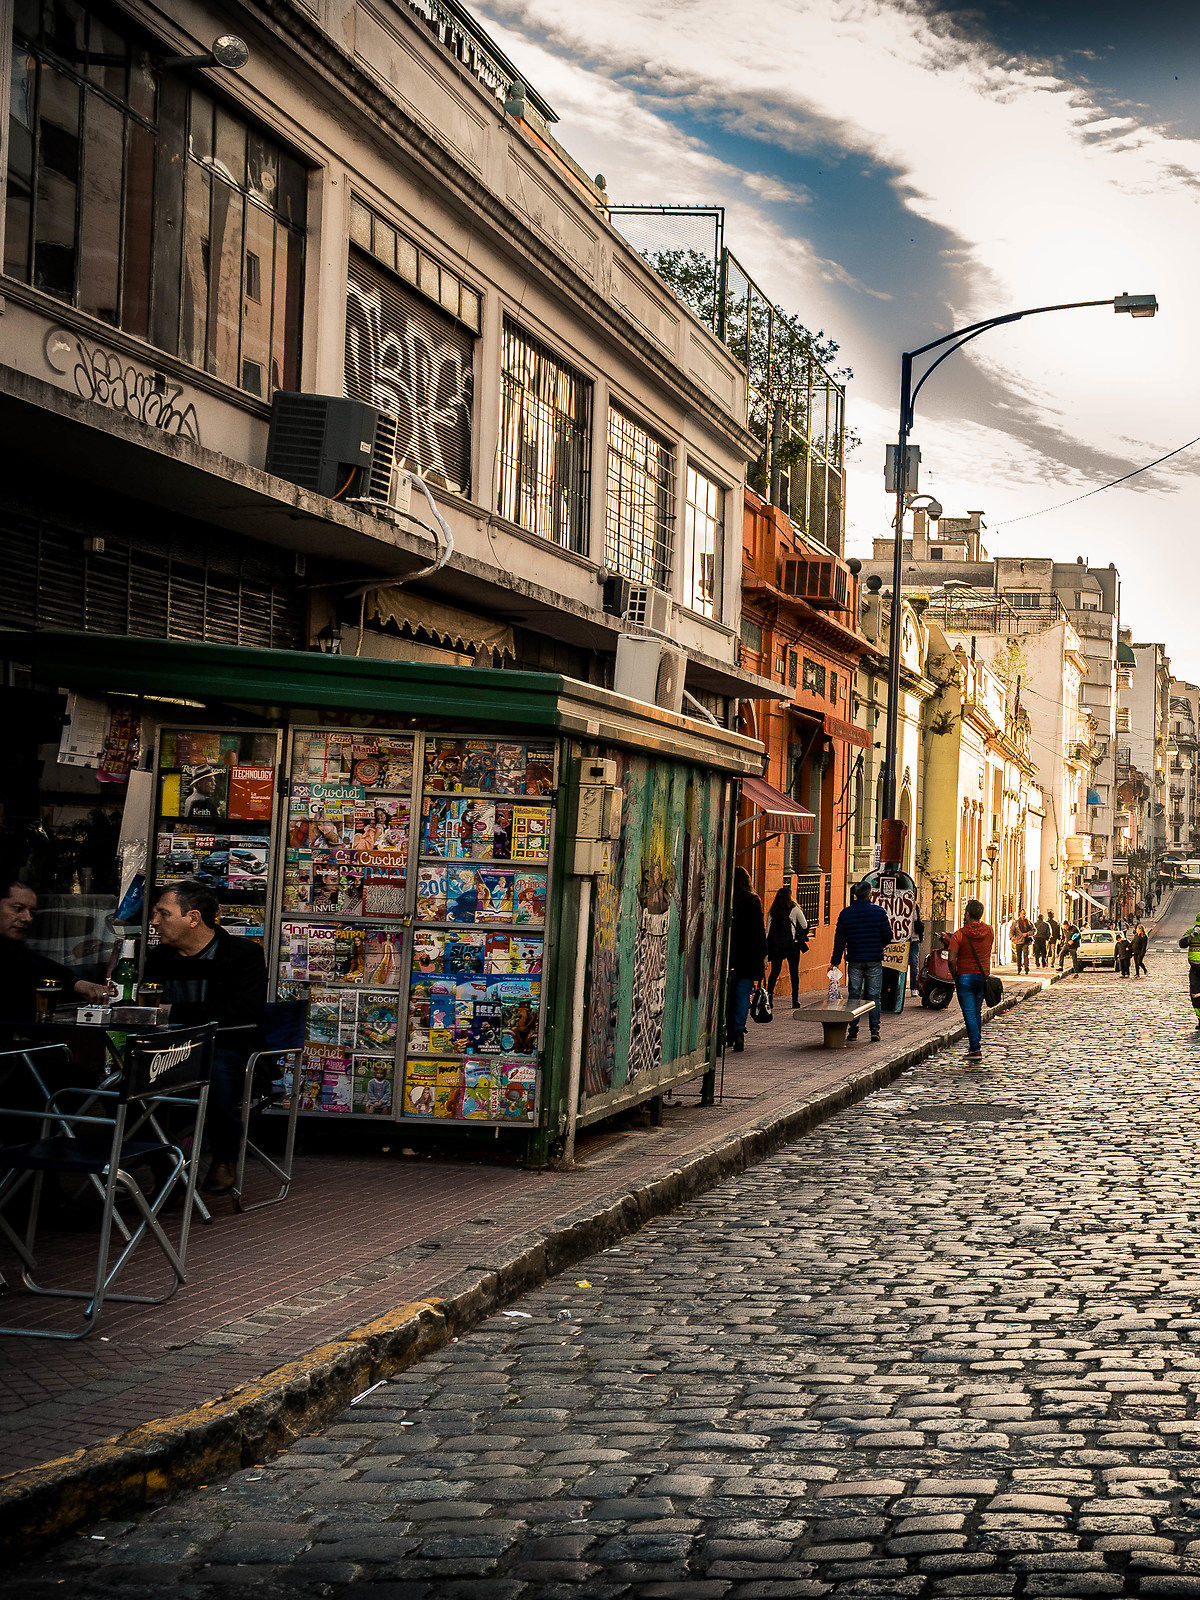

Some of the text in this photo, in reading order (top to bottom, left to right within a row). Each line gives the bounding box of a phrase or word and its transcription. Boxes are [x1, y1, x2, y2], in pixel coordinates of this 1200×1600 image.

[312, 784, 361, 799] Crochet
[360, 852, 408, 866] Crochet
[302, 1046, 344, 1059] rochet
